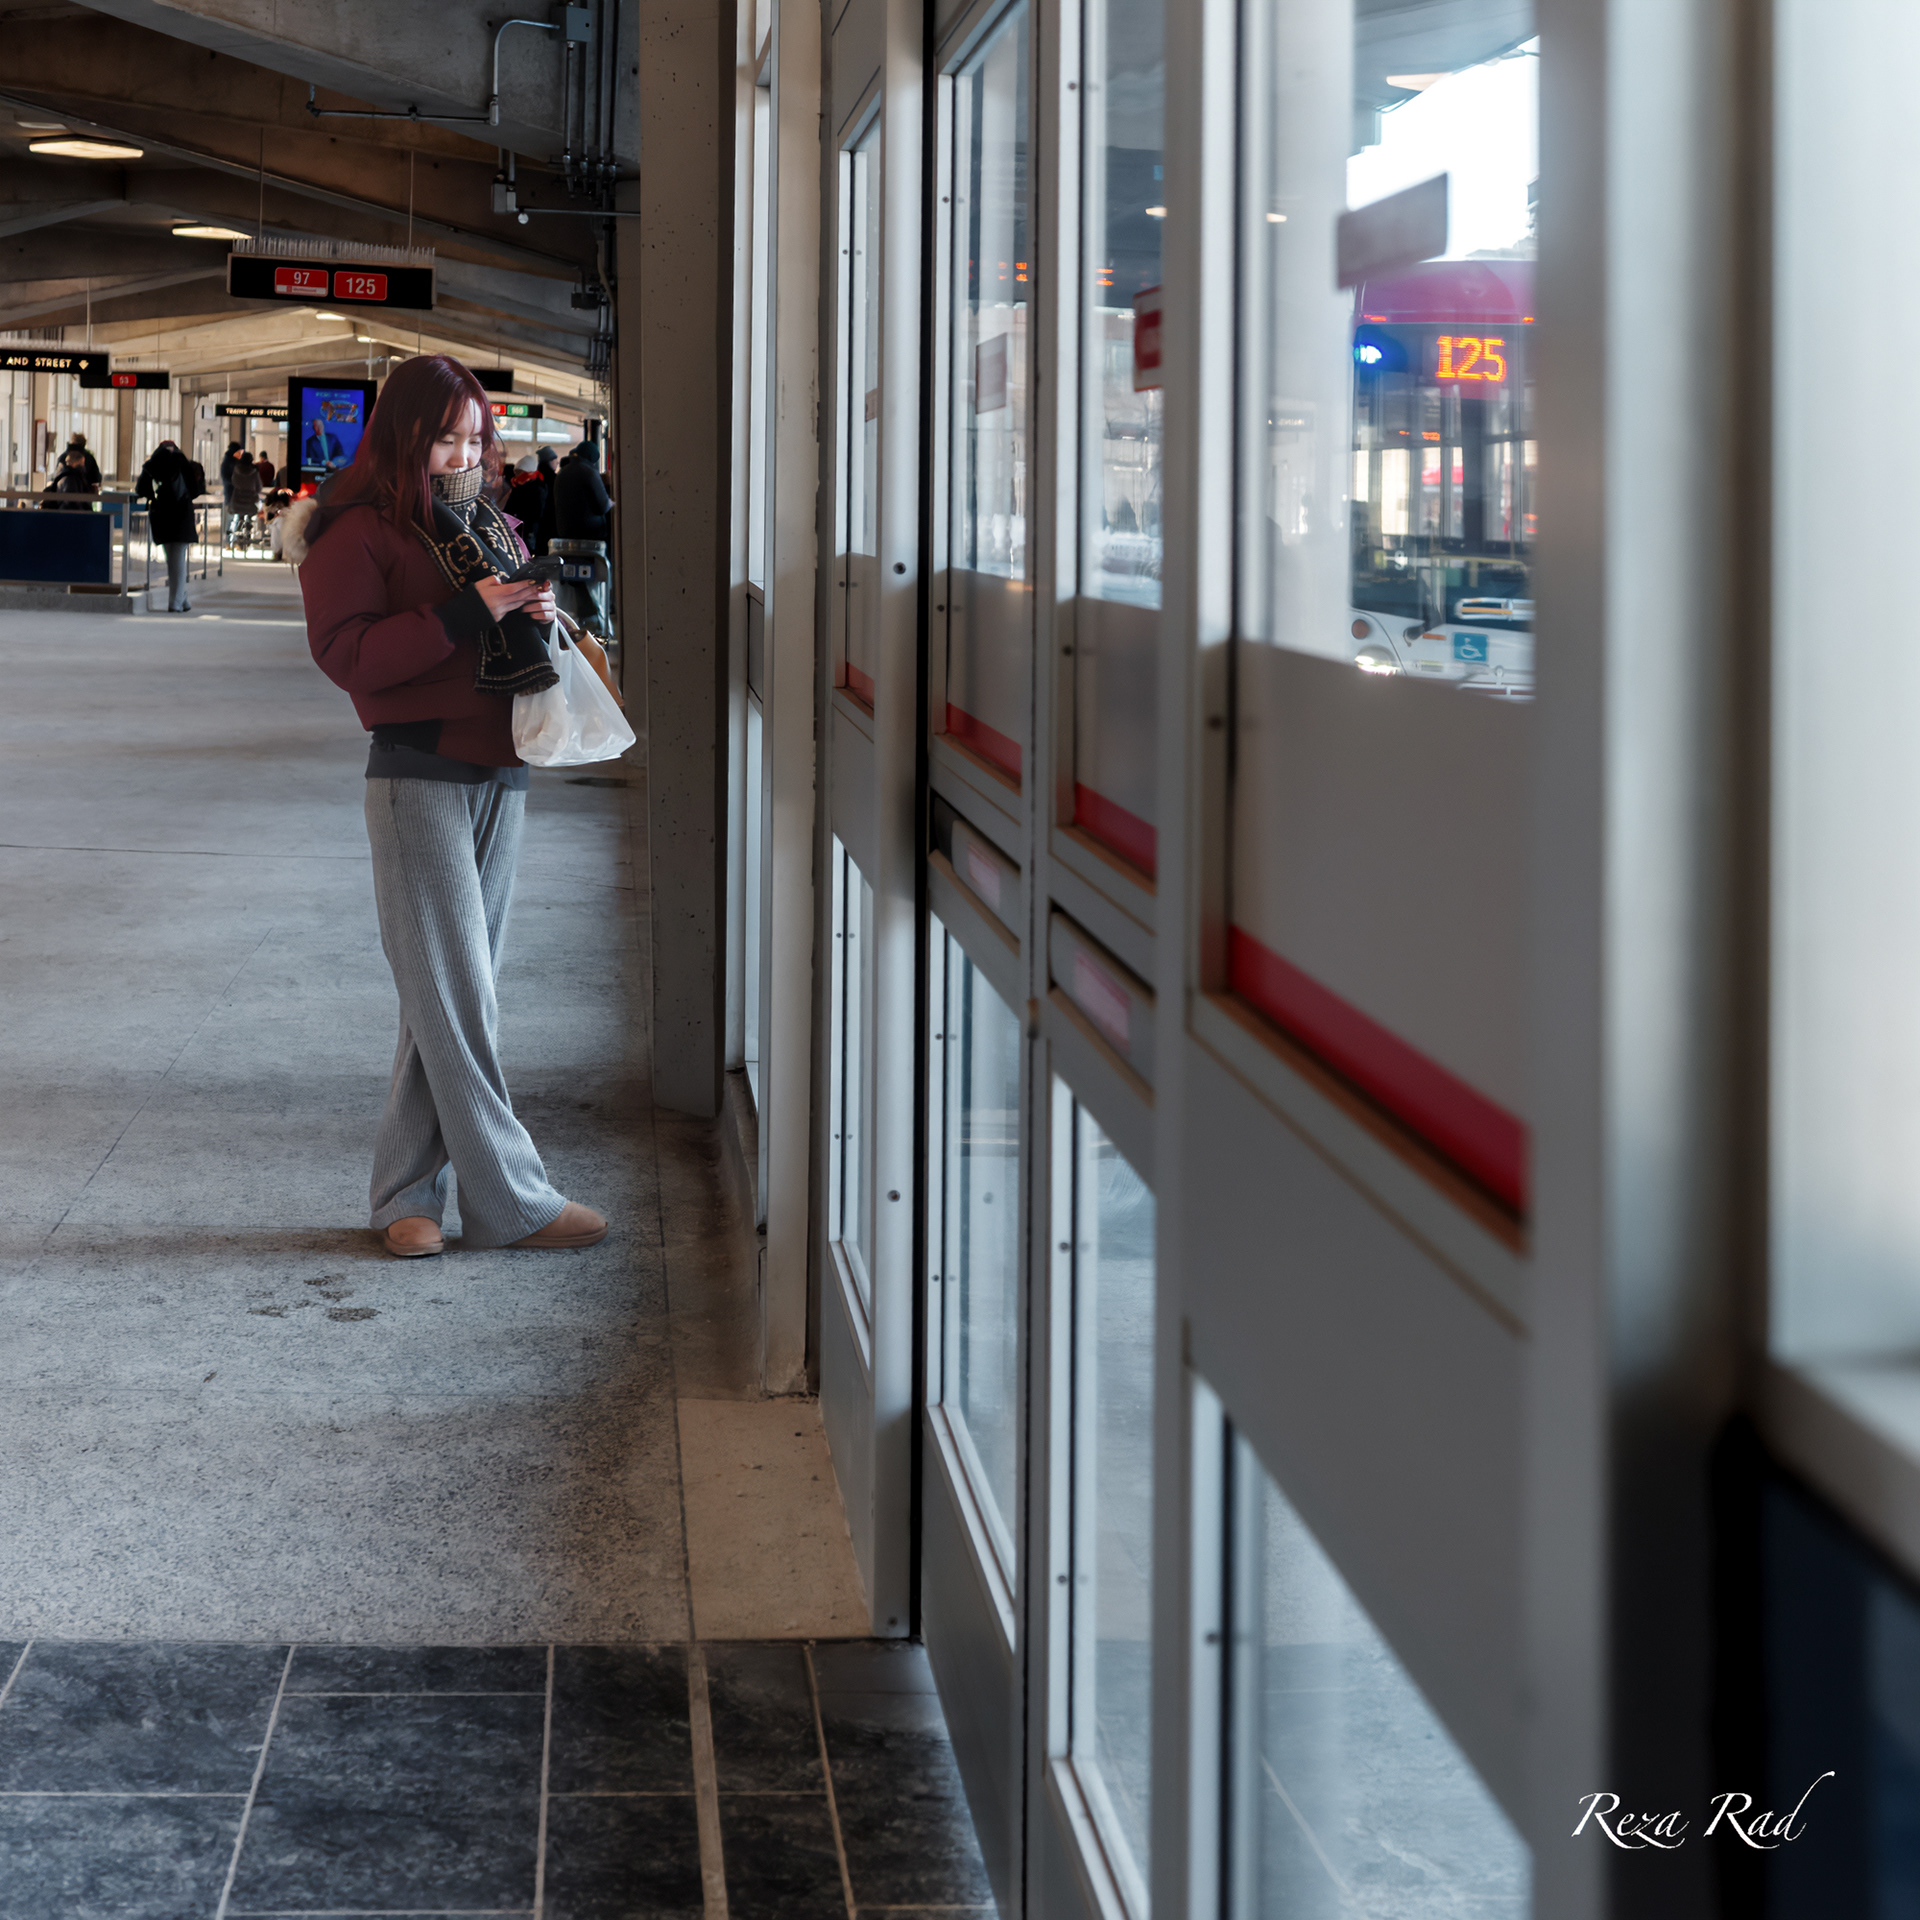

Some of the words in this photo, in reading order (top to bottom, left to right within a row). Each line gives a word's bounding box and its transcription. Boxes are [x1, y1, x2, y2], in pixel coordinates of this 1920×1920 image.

[293, 271, 310, 285] 97
[346, 277, 376, 295] 125
[6, 356, 29, 366] AND
[34, 357, 72, 369] STREET
[1435, 335, 1507, 383] 125
